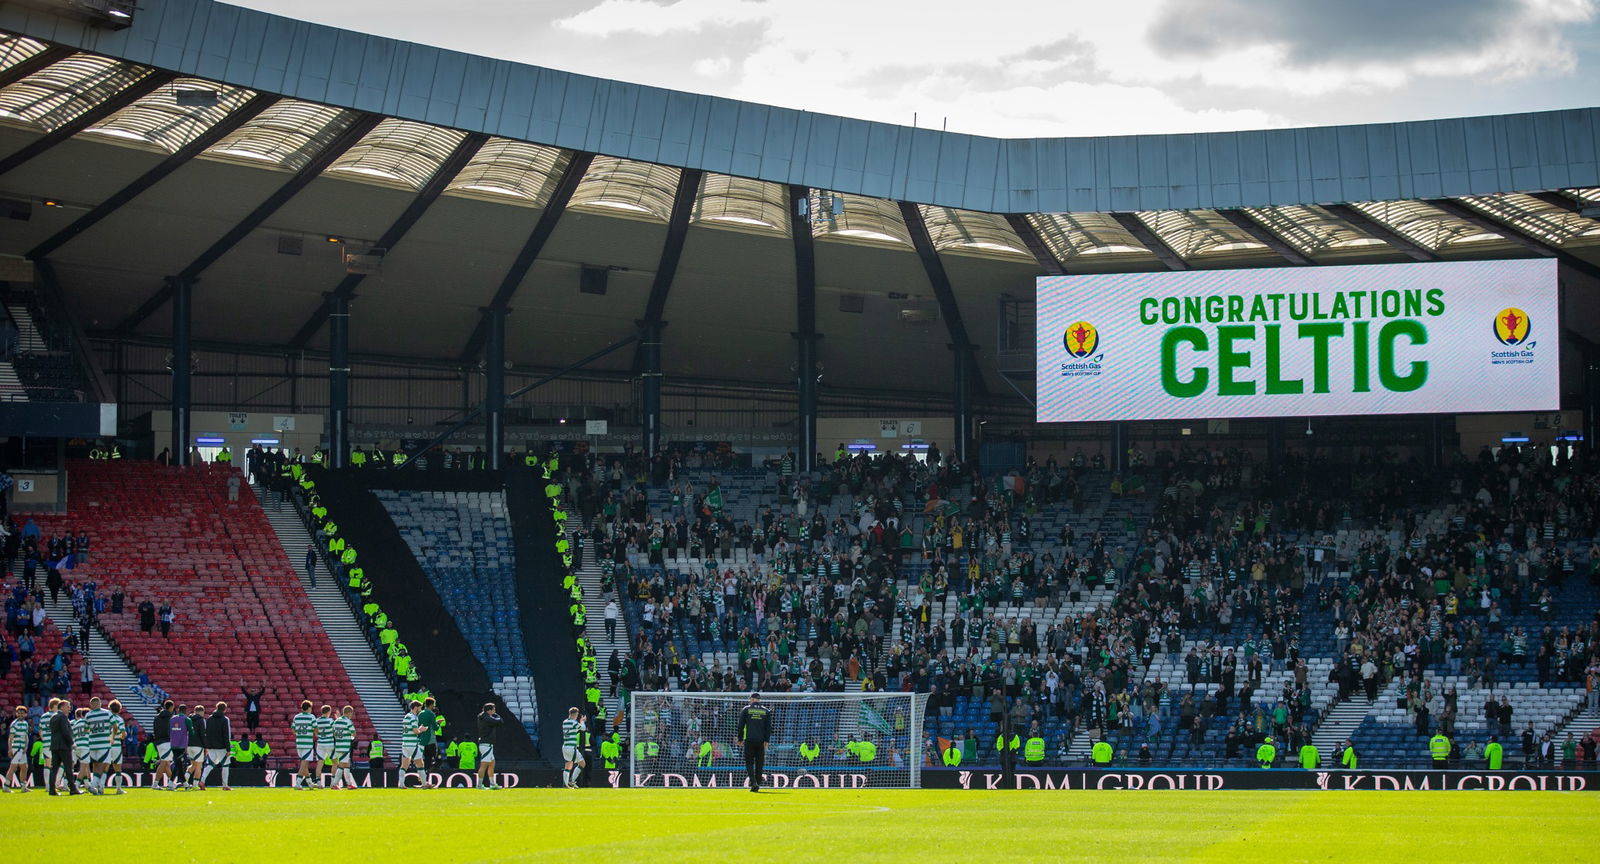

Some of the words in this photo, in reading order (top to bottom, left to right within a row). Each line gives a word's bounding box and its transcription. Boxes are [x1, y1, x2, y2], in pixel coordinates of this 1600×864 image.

[1140, 288, 1445, 325] CONGRATULATIONS
[1160, 319, 1429, 398] CELTIC
[22, 481, 30, 490] 3
